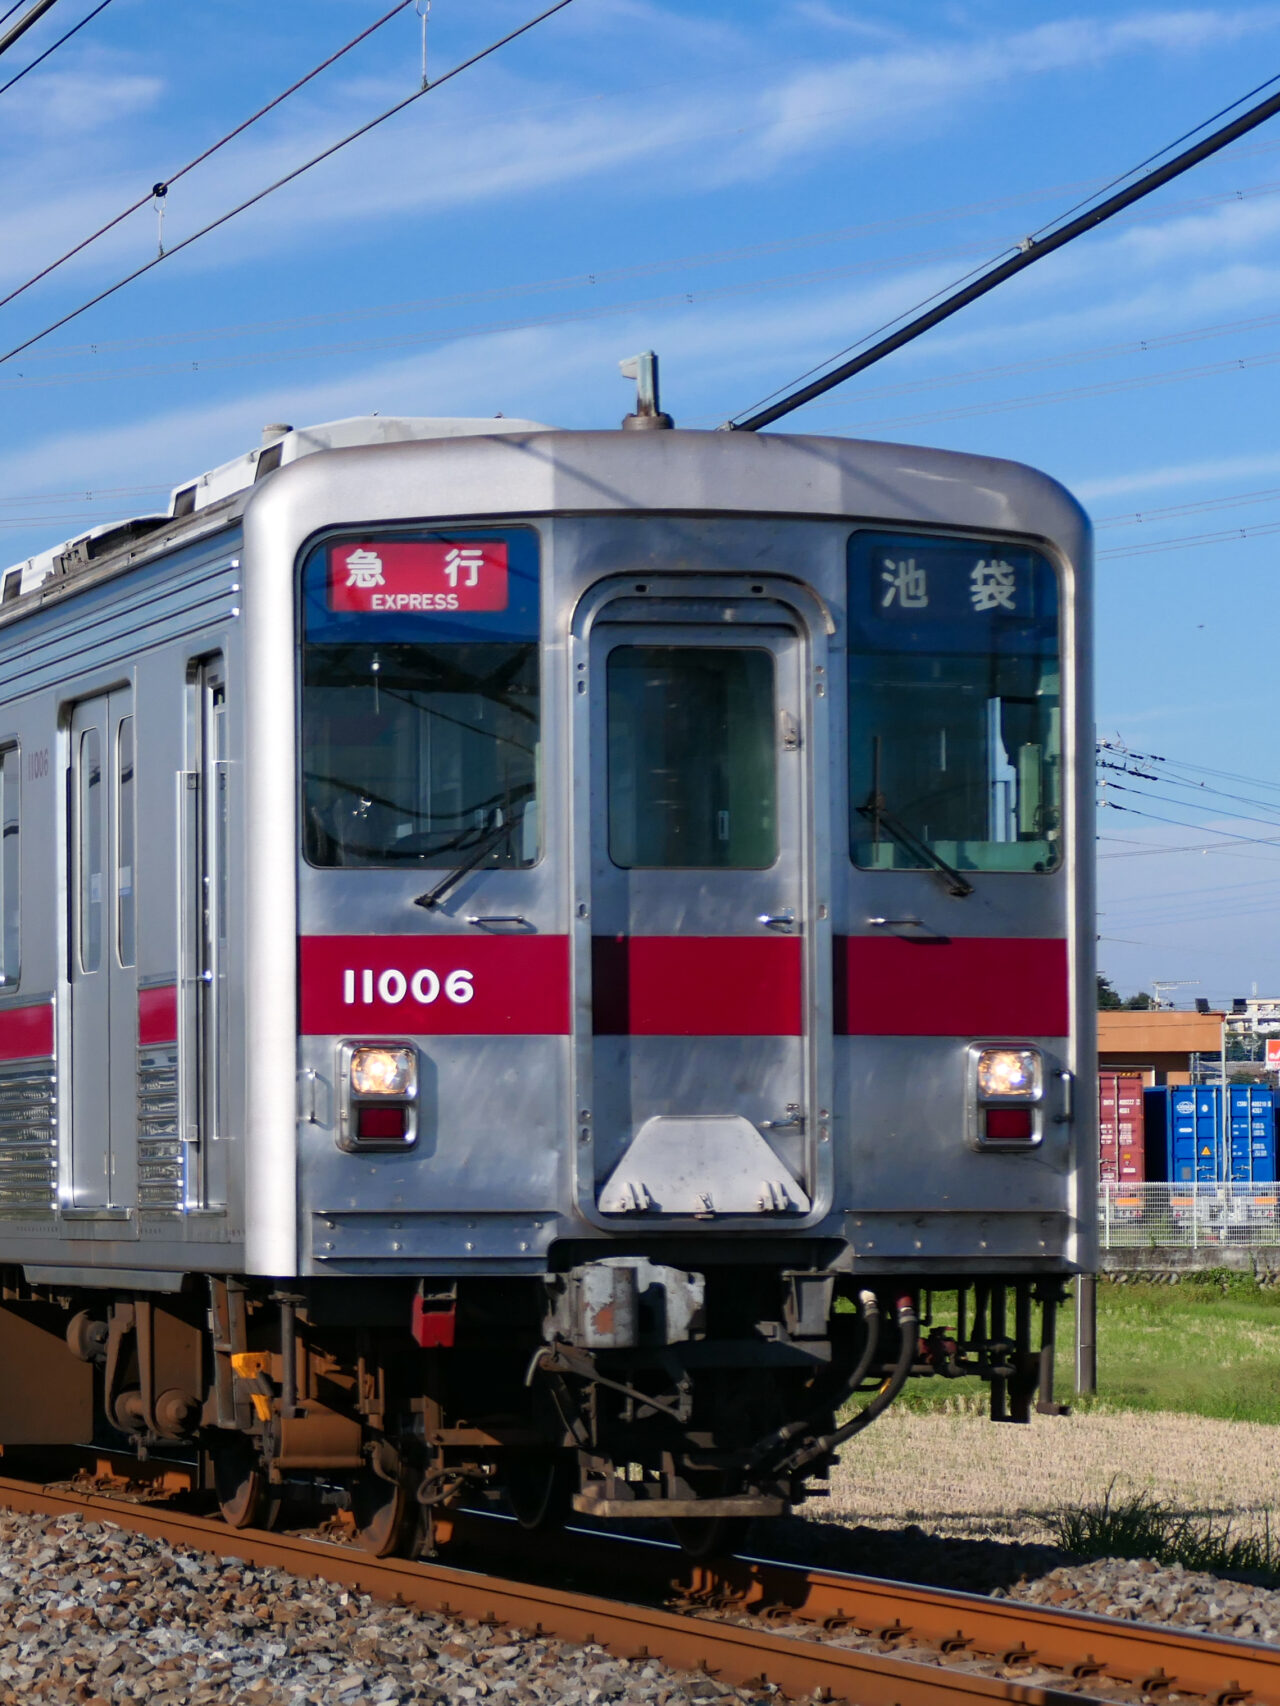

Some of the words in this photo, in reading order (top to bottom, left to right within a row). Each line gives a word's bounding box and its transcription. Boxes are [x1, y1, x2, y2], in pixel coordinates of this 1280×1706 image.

[345, 548, 484, 588] 急行
[881, 558, 1017, 611] 池袋
[371, 593, 459, 610] EXPRESS
[344, 969, 474, 1004] 11006
